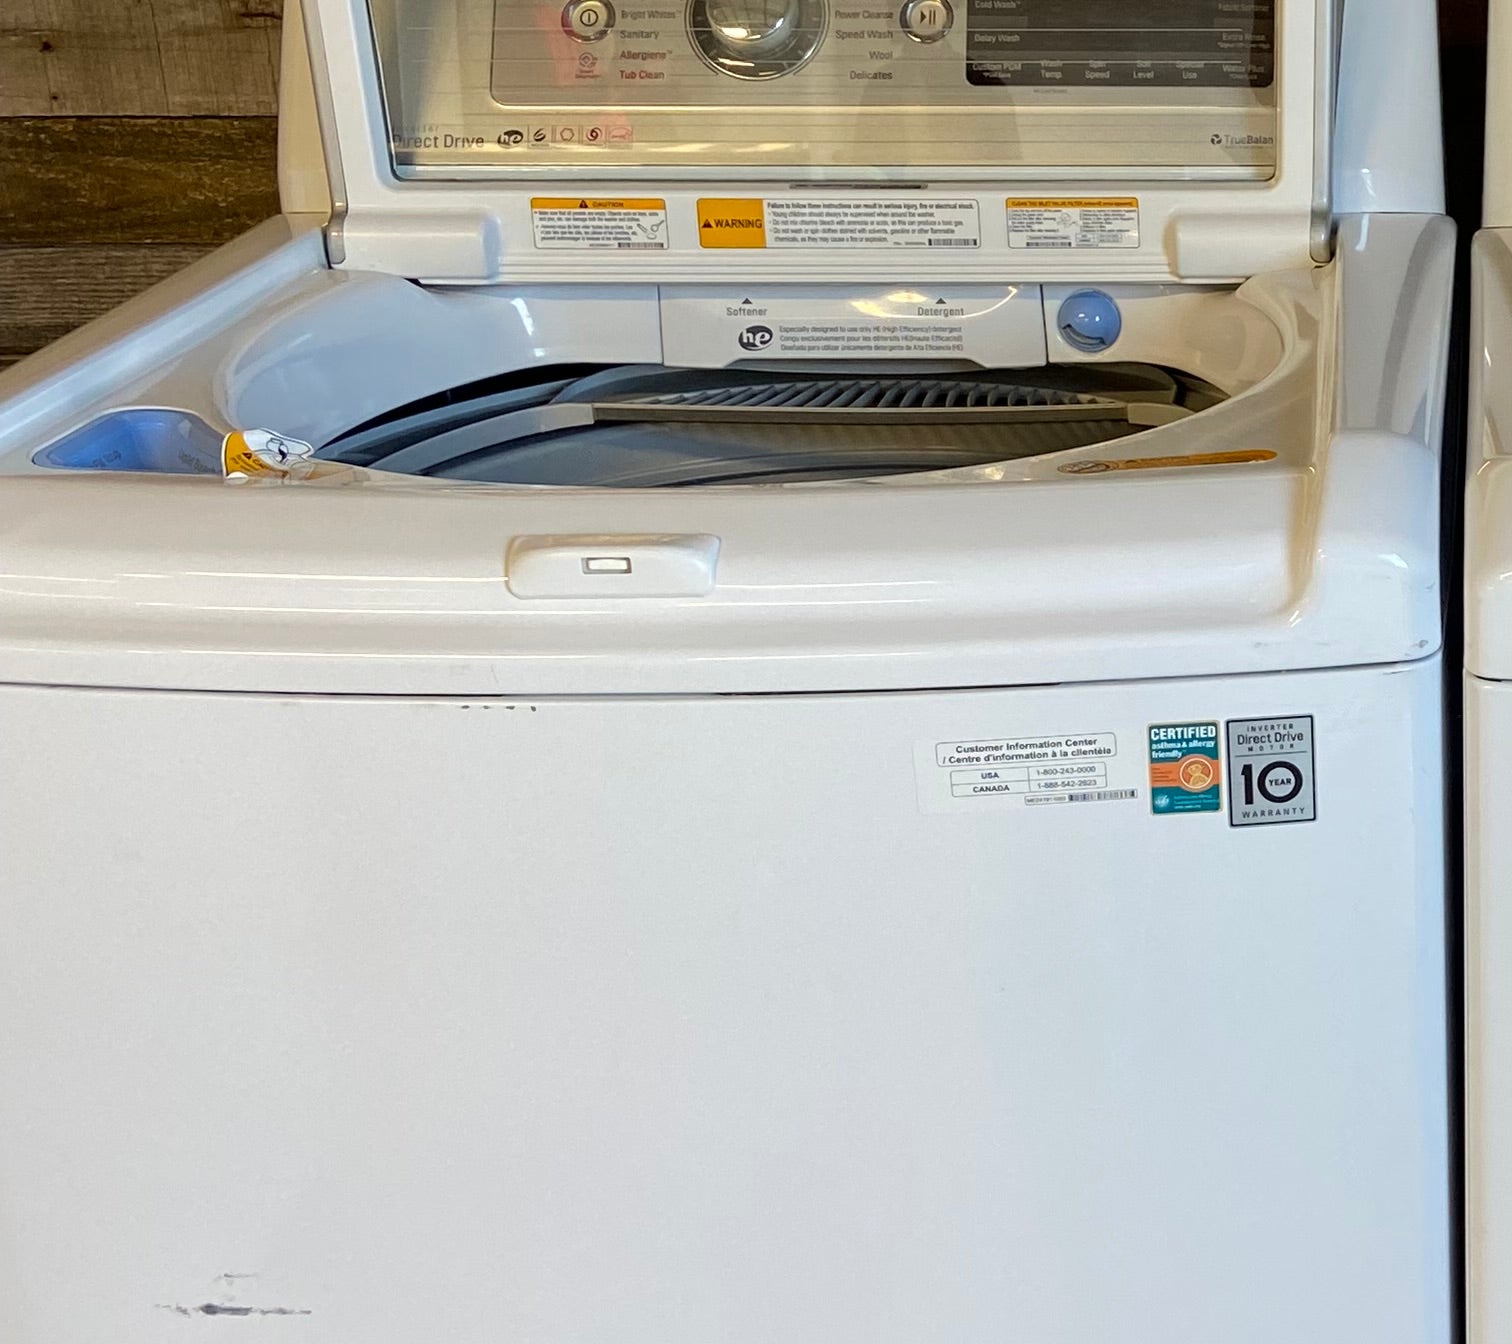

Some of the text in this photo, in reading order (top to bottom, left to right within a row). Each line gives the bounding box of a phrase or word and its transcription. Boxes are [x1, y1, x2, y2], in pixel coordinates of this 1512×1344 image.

[620, 30, 660, 40] Sanitary
[835, 29, 894, 40] Speed Wash
[868, 50, 894, 60] Wool
[619, 69, 665, 80] Tub Clean
[849, 69, 894, 80] Delicates
[393, 134, 440, 149] Direct
[443, 134, 485, 149] Drive
[713, 218, 763, 229] WARNING
[726, 306, 768, 316] Softener
[917, 306, 965, 318] Detergent
[1150, 725, 1217, 740] CERTIFIED
[1246, 723, 1294, 732] INVERTER
[1236, 731, 1305, 745] Direct Drive
[955, 738, 1098, 754] Customer Information Center
[1247, 744, 1295, 753] MOTOR
[948, 755, 982, 765] Centre
[984, 752, 1050, 763] d'information
[1059, 749, 1069, 758] la
[980, 772, 1000, 780] USA
[1240, 760, 1304, 805] 10
[1268, 777, 1292, 787] YEAR
[972, 785, 1011, 794] CANADA
[1241, 807, 1305, 819] WARRANTY
